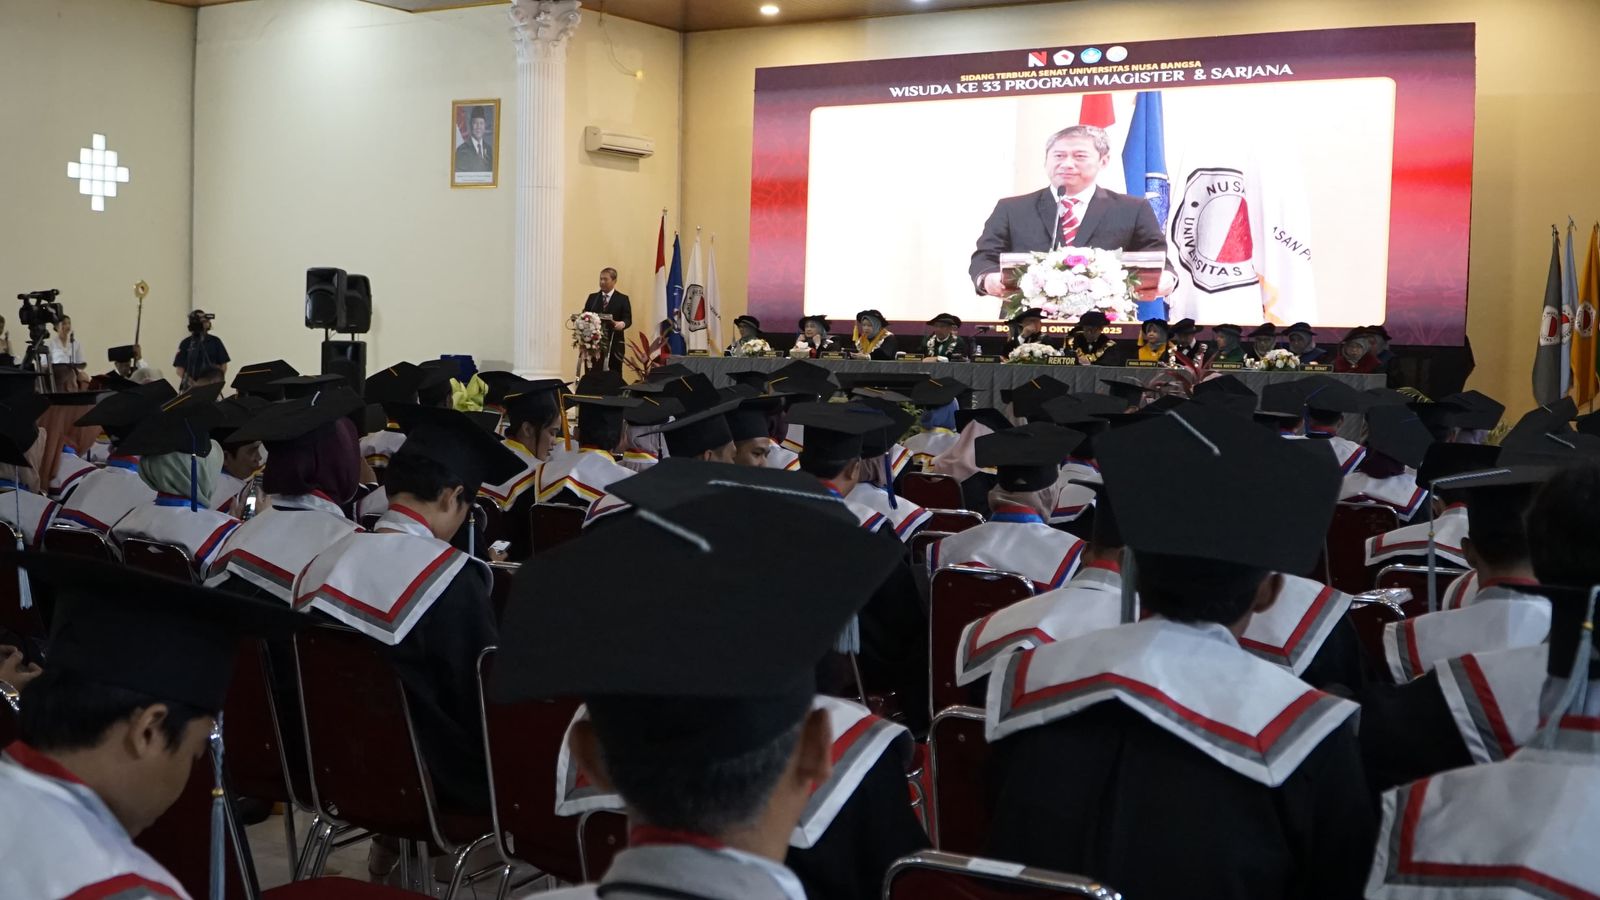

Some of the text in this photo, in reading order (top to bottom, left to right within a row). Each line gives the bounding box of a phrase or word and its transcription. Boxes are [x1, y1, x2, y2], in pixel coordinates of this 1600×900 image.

[889, 63, 1294, 97] WISUDA KE 33 PROGRAM MAGISTER & SARJANA
[960, 60, 1202, 82] SIDANG TERBUKA SENAT UNIVERSITAS NUSA BANGSA
[1183, 217, 1243, 277] UNIVERSITAS
[1101, 326, 1122, 334] 025
[1048, 356, 1076, 365] REKTOR
